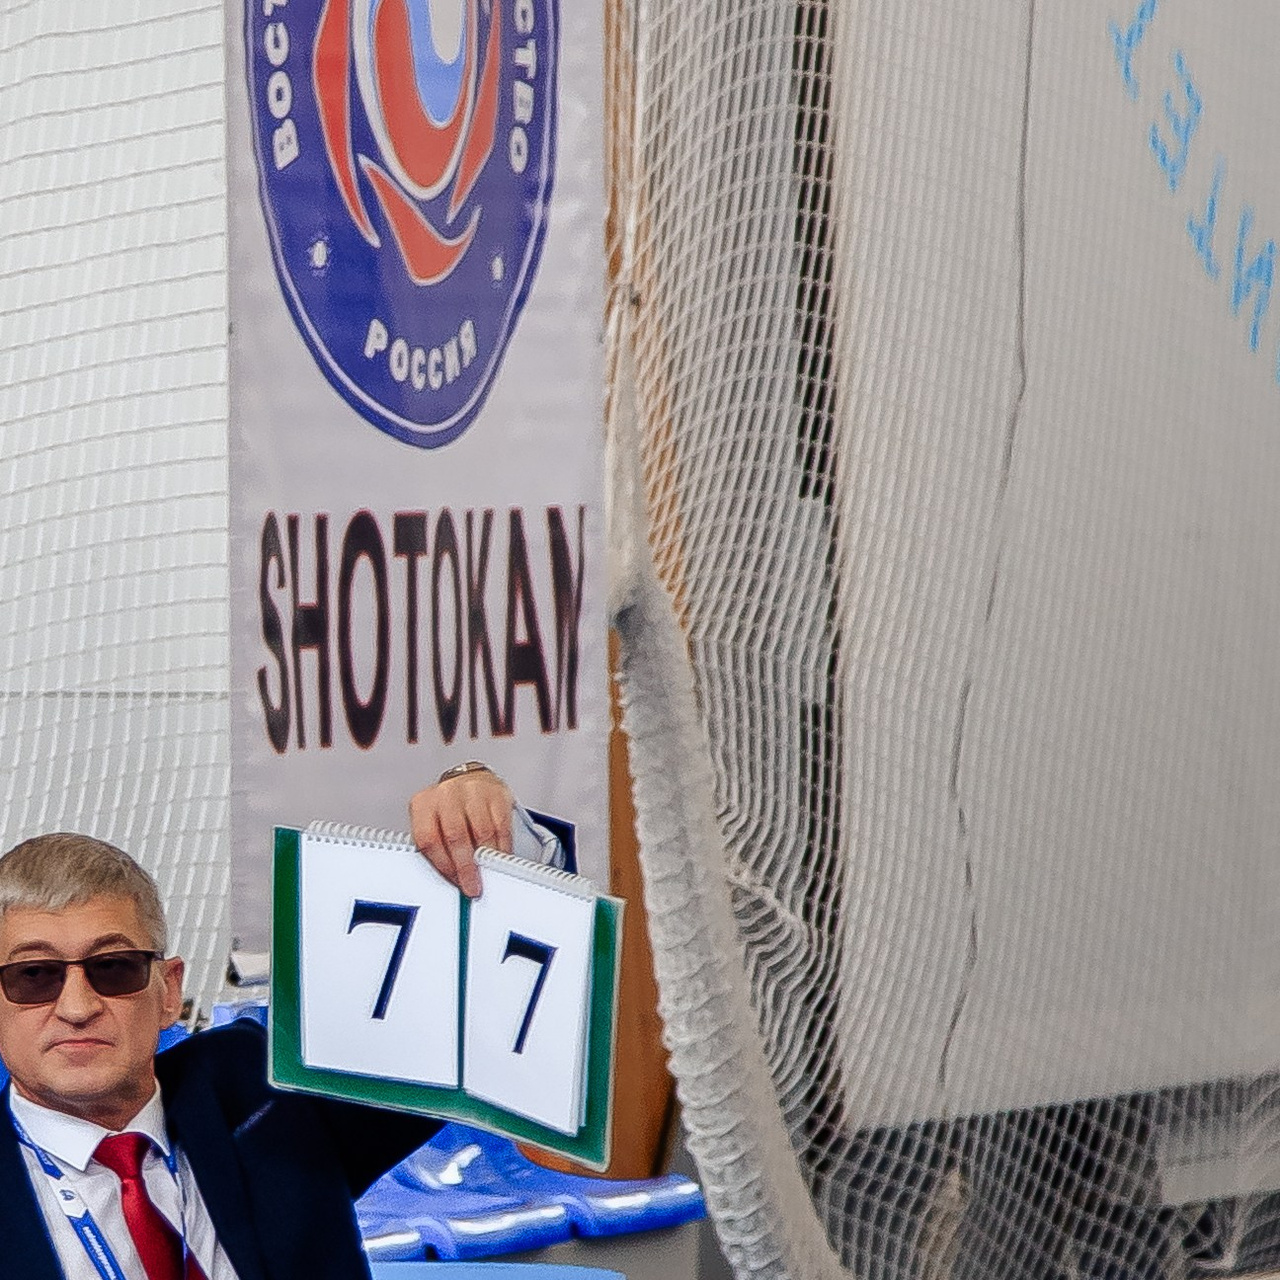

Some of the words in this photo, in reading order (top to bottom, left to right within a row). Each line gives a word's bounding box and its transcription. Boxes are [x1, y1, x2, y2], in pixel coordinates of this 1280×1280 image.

[364, 319, 477, 391] РОССИЯ
[256, 503, 586, 754] SHOTOKAN
[347, 898, 421, 1020] 7
[501, 930, 558, 1054] 7
